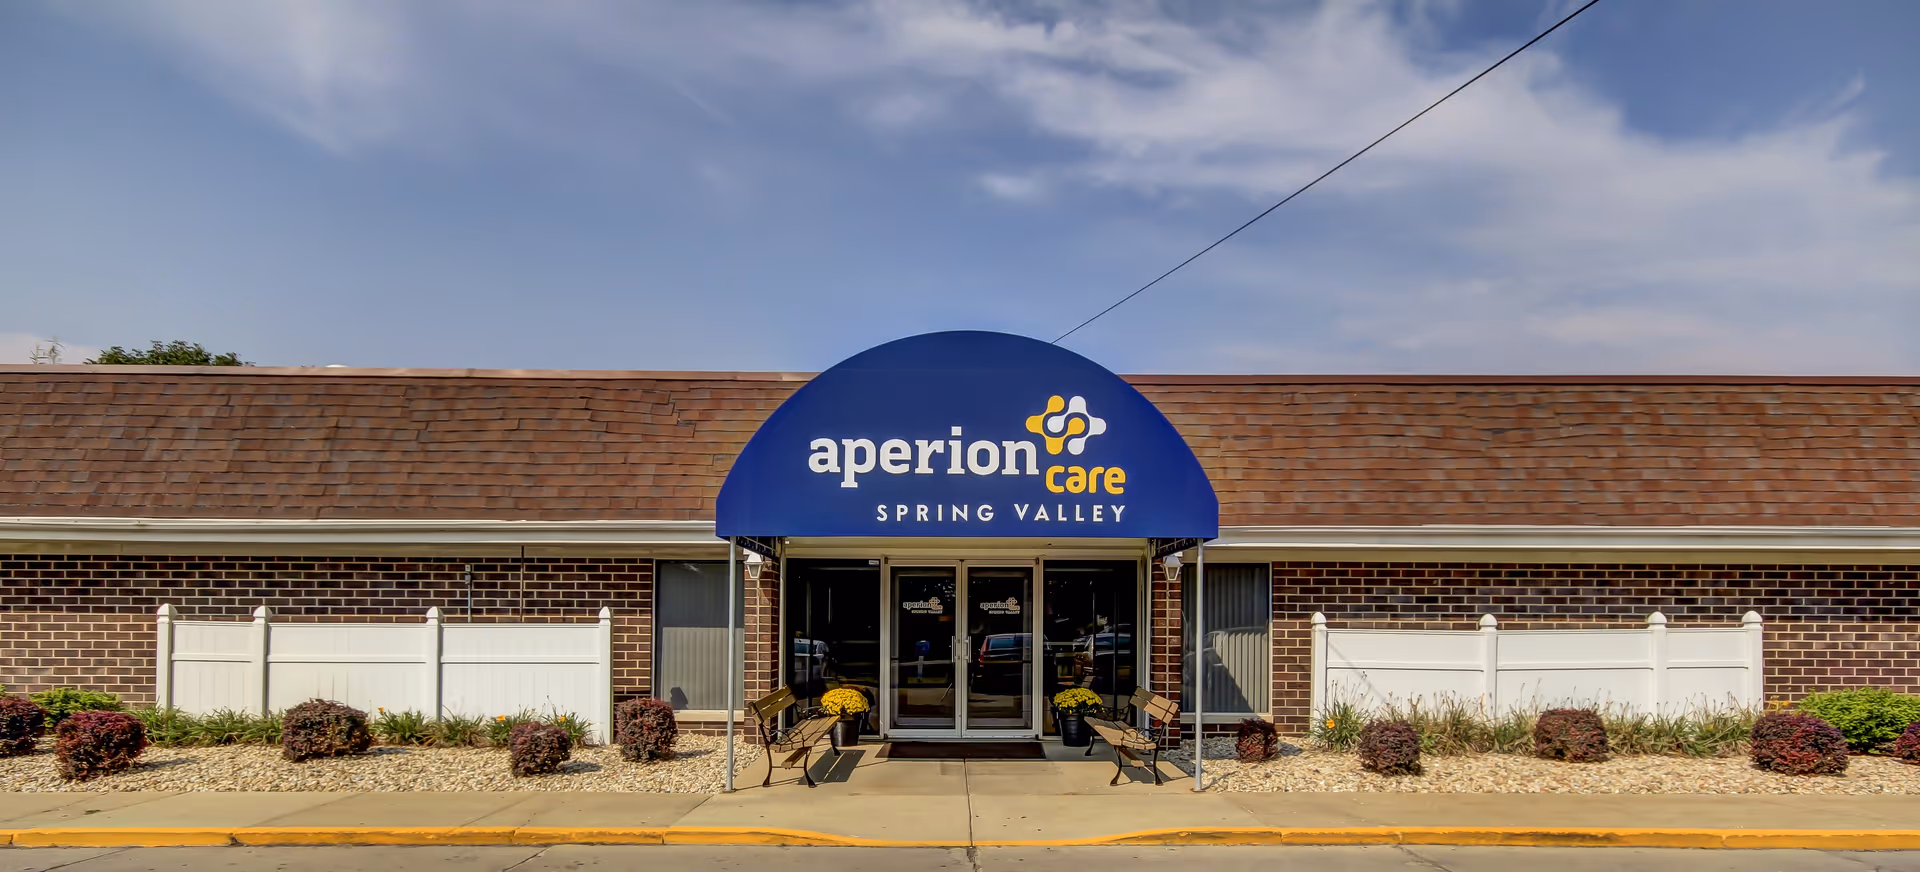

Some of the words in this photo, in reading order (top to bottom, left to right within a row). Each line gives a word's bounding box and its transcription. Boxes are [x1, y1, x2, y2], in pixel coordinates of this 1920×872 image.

[808, 426, 1039, 488] aperion
[1045, 465, 1126, 495] care
[876, 504, 994, 522] SPRING
[1013, 503, 1126, 523] VALLEY
[903, 600, 932, 610] aperion
